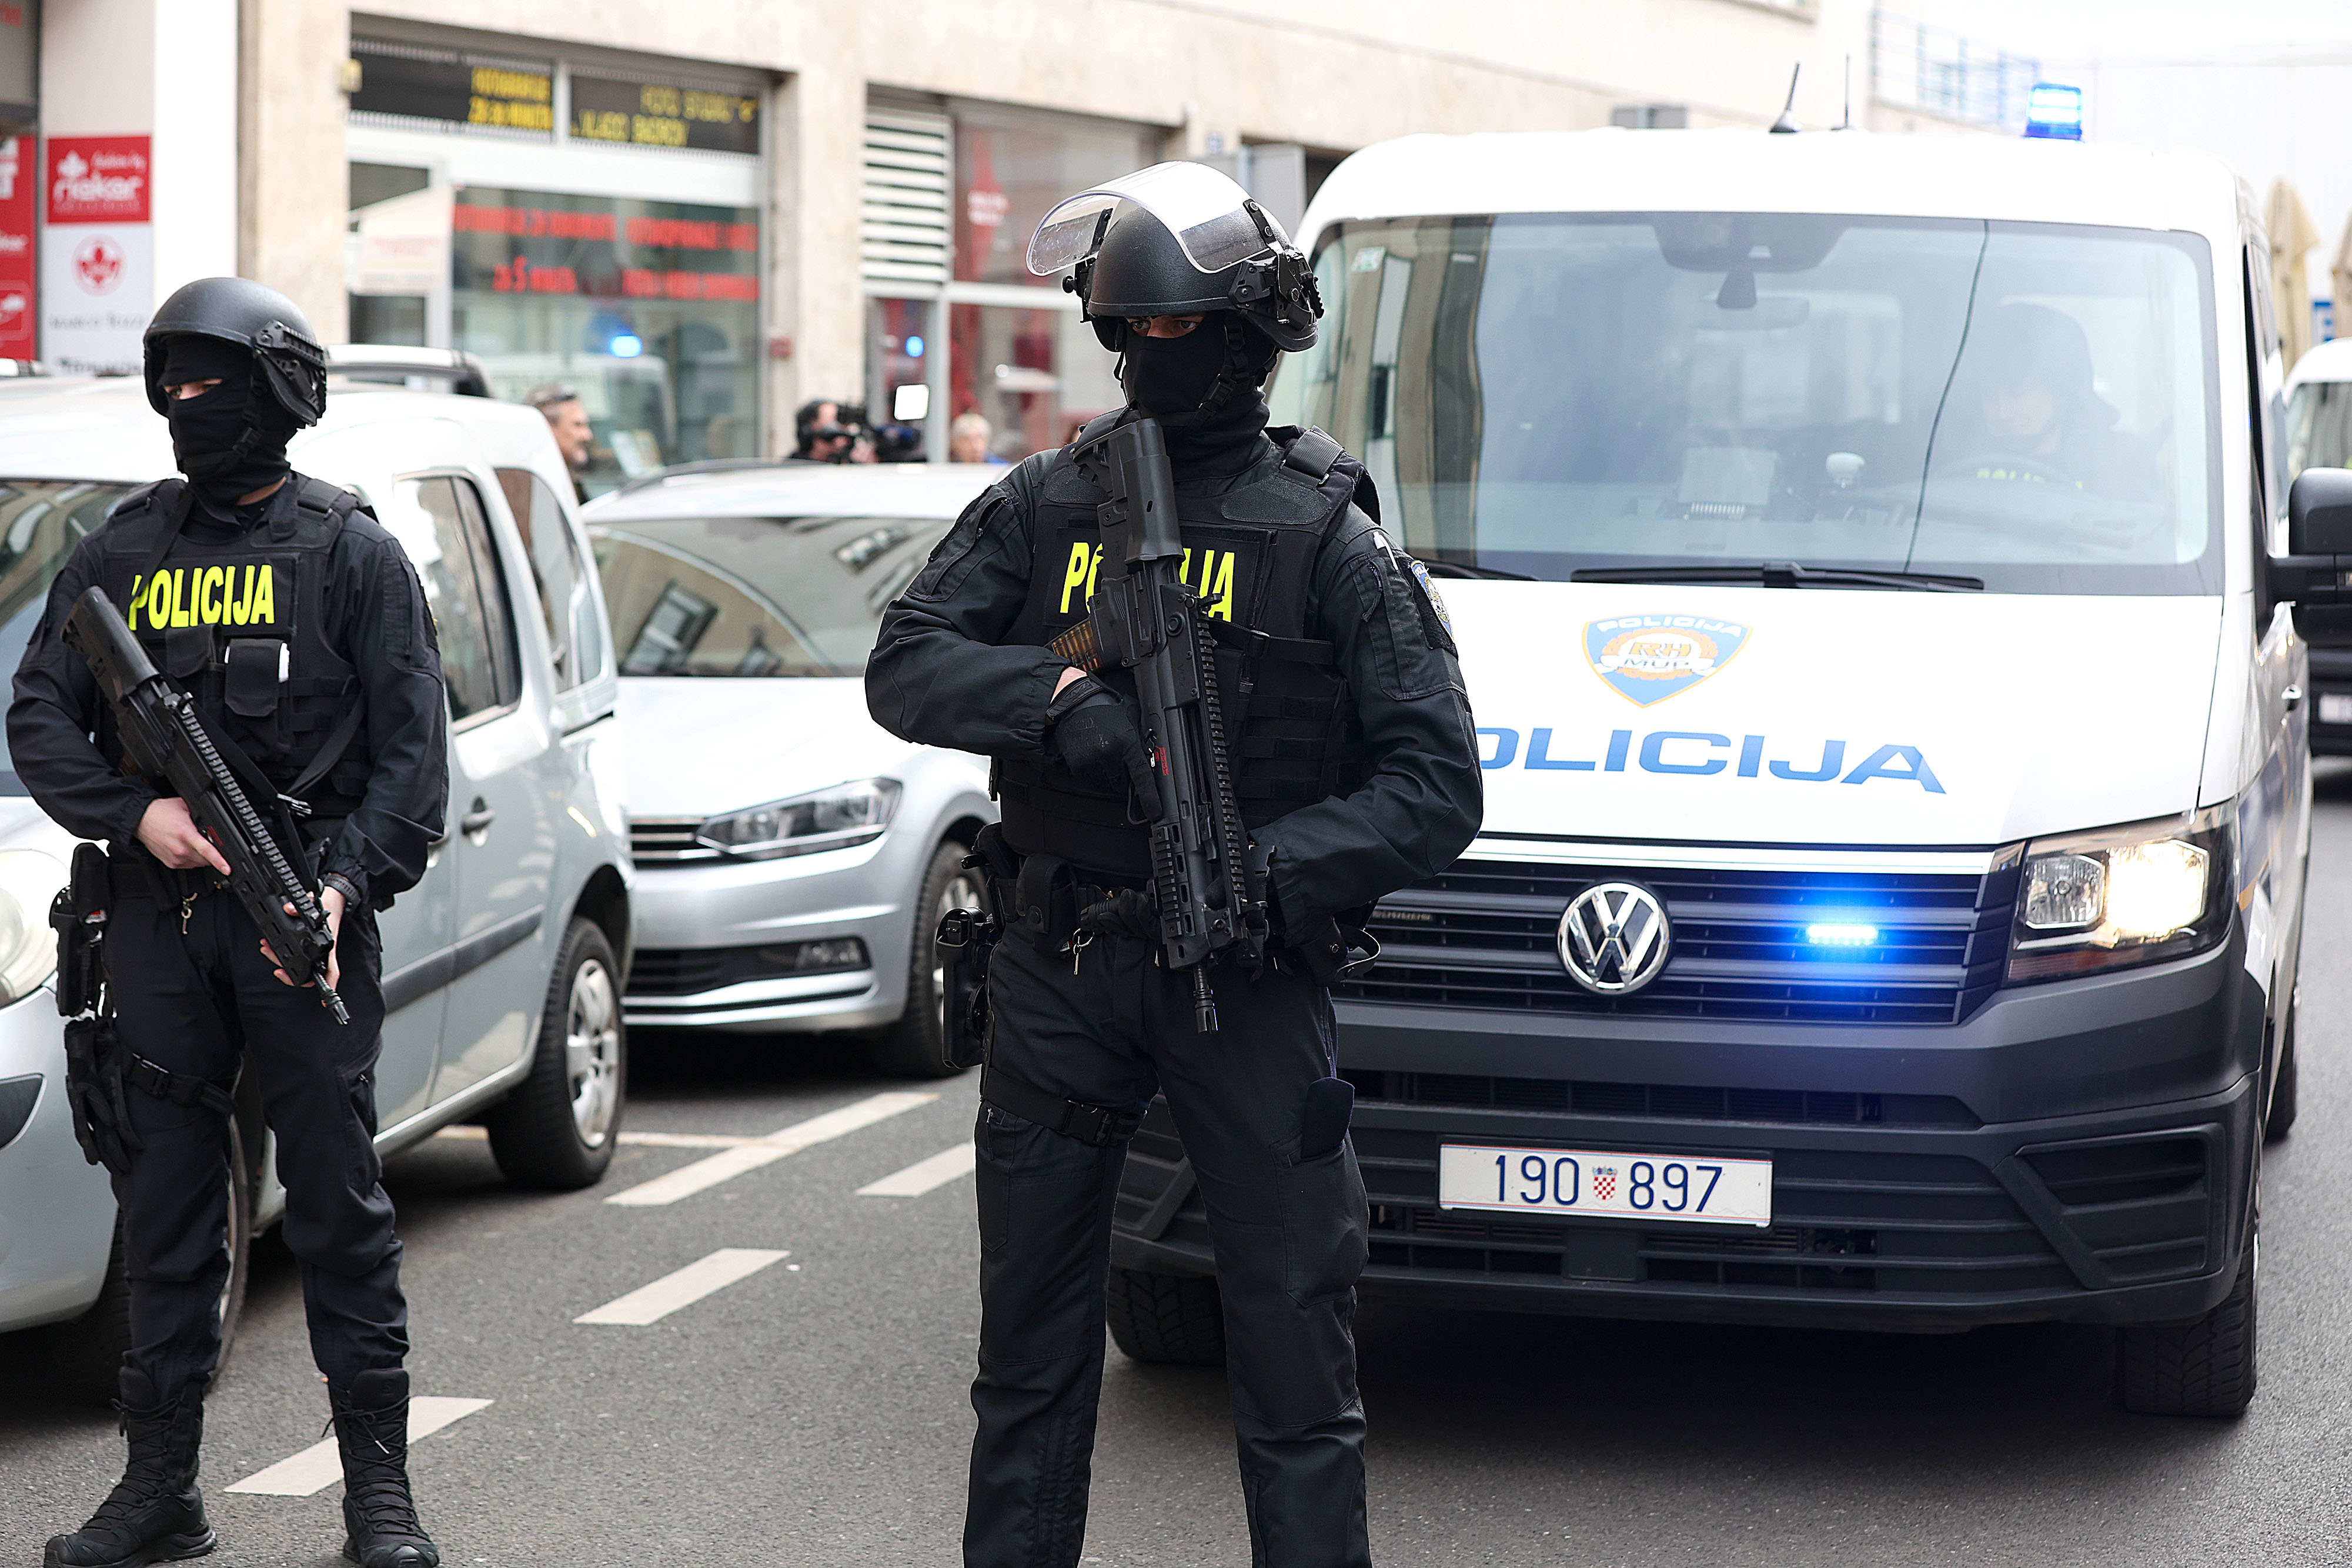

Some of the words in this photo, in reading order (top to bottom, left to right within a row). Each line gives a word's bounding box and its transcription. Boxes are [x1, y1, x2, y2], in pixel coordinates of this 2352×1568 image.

[128, 565, 275, 631] POLICIJA
[1597, 616, 1742, 638] POLICIJA
[1623, 657, 1689, 667] MUP
[1495, 1154, 1579, 1206] 190
[1629, 1161, 1723, 1213] 897
